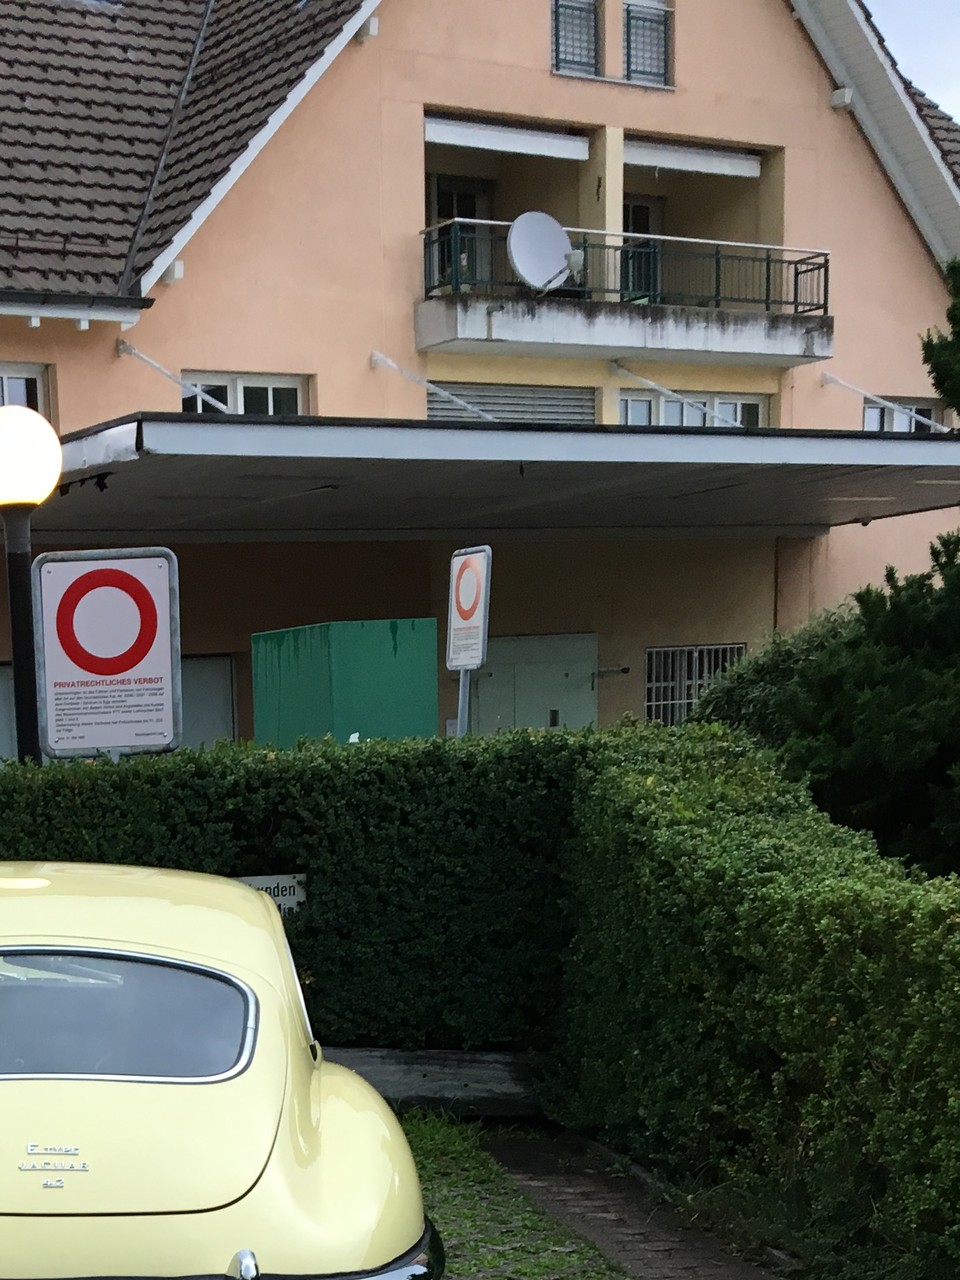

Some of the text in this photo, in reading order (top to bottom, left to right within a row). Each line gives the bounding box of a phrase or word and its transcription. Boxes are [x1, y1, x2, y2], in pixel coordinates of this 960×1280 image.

[53, 677, 164, 688] PRIVATRECHTLICHES VERBOT
[27, 1143, 39, 1155] E
[18, 1161, 88, 1172] JAGUAR
